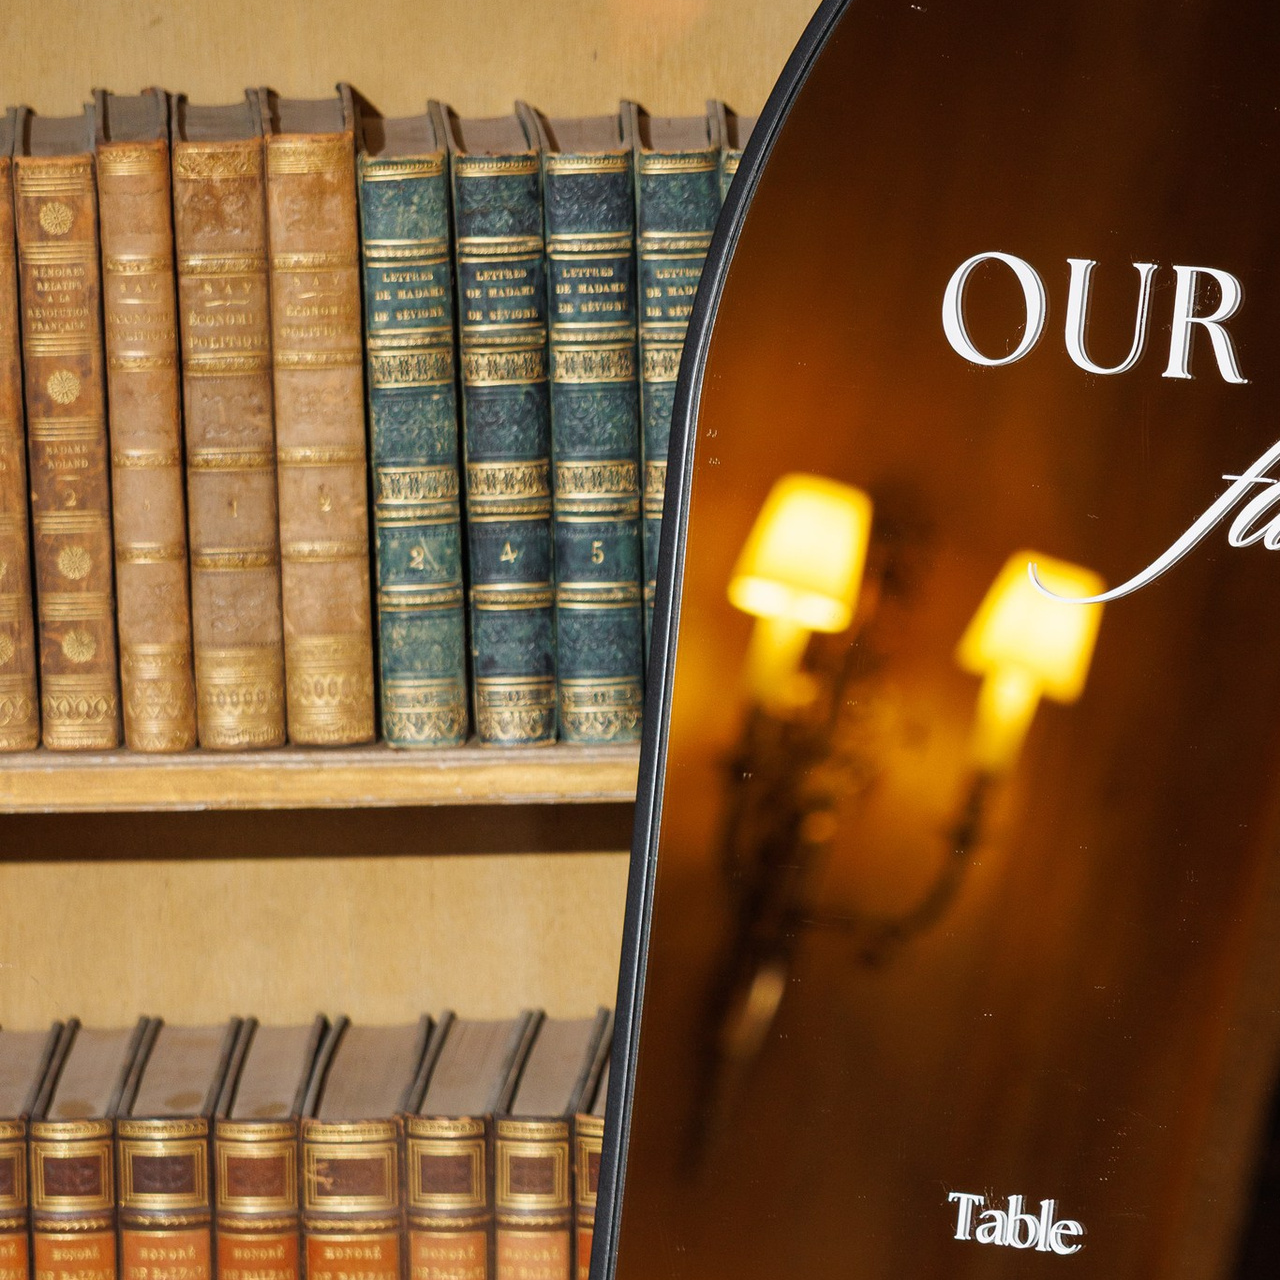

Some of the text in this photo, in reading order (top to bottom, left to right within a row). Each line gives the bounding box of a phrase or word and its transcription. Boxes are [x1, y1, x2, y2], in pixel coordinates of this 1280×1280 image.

[382, 271, 434, 283] LETTRES
[475, 268, 527, 281] LETTRES
[562, 267, 614, 278] LETTRES
[466, 289, 482, 299] DE
[556, 282, 627, 294] DE MADAME
[375, 291, 391, 301] DE
[558, 303, 574, 314] DE
[188, 310, 253, 326] ÉCONOMI
[374, 311, 389, 322] DE
[467, 310, 483, 321] DE
[942, 252, 1248, 383] OUR
[410, 546, 425, 570] 2
[500, 541, 517, 564] 4
[592, 540, 605, 564] 5
[948, 1193, 1083, 1254] Table
